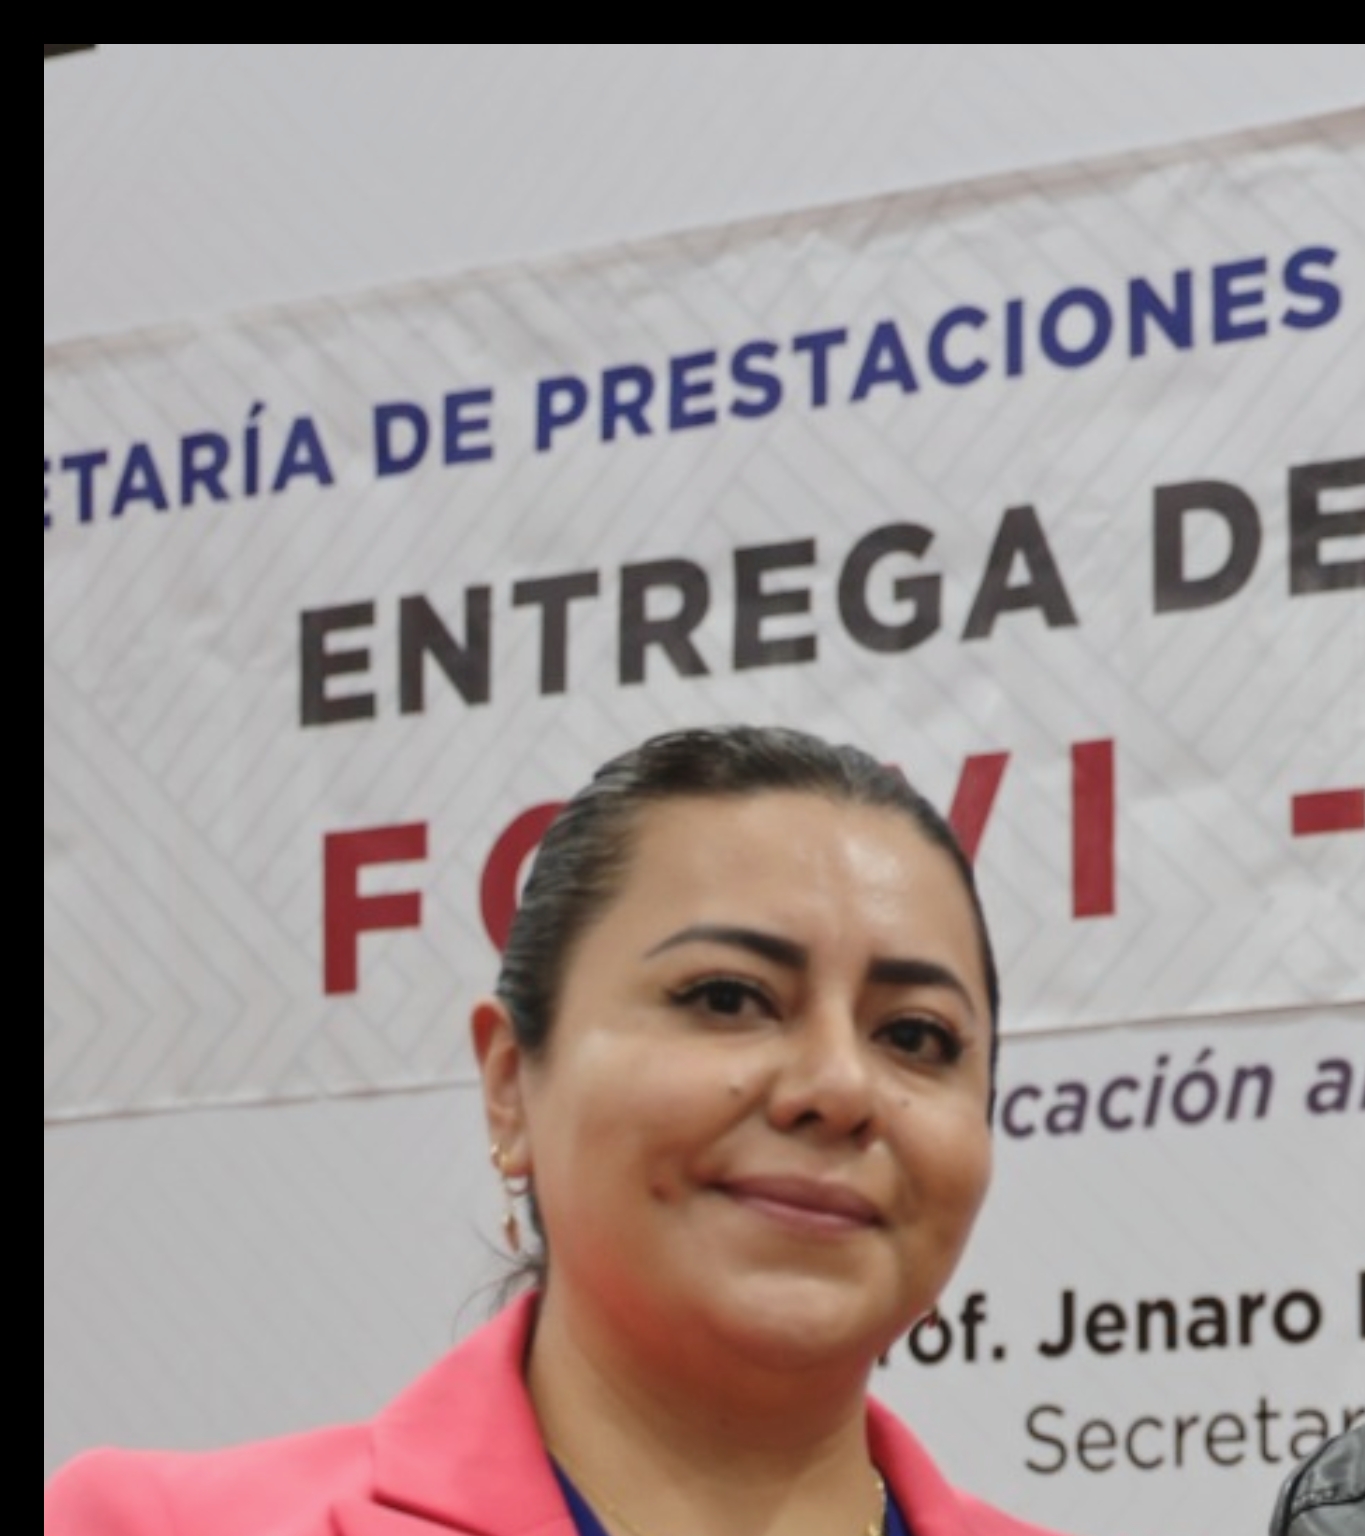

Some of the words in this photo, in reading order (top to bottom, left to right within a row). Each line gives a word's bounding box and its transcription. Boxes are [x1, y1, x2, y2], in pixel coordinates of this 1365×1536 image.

[44, 402, 333, 529] TARÍA
[374, 389, 492, 476] DE
[536, 247, 1340, 451] PRESTACIONES
[300, 506, 1077, 727] ENTREGA
[1001, 1049, 1274, 1139] cación
[878, 1292, 1006, 1366] of.
[1038, 1290, 1322, 1358] Jenaro
